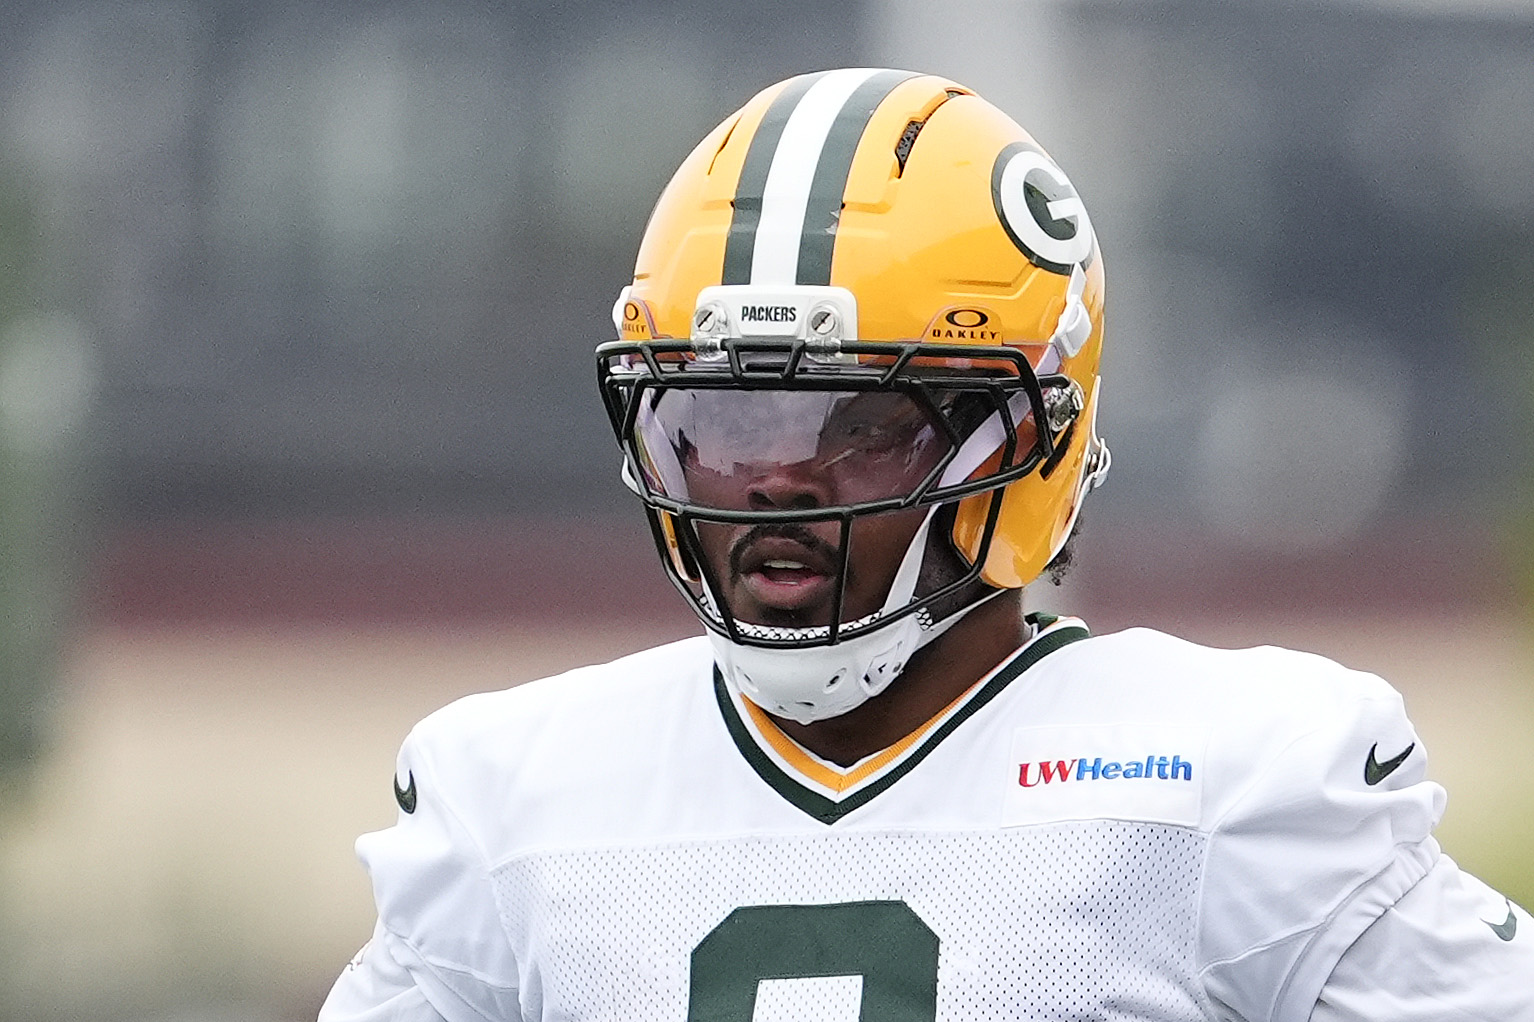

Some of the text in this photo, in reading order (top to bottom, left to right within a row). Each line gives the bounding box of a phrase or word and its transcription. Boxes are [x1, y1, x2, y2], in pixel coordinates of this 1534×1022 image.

[1000, 151, 1092, 264] G
[741, 305, 797, 322] PACKERS
[932, 328, 1000, 340] OAKLEY
